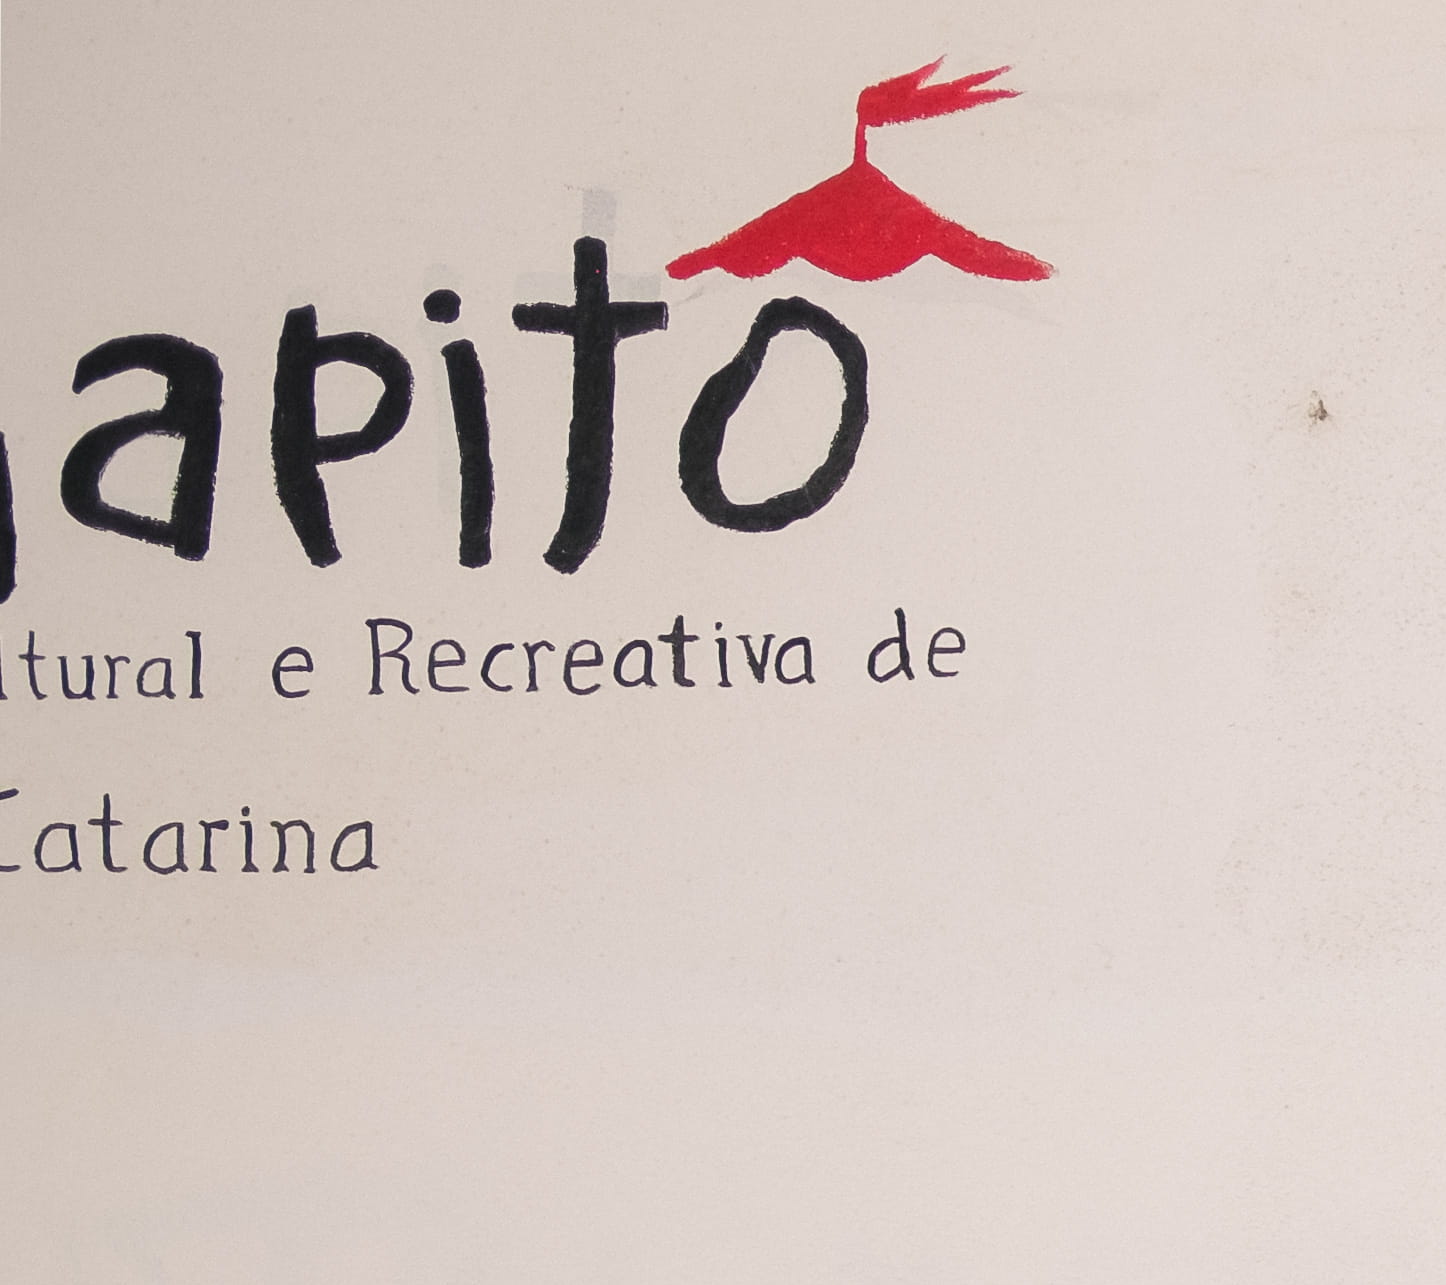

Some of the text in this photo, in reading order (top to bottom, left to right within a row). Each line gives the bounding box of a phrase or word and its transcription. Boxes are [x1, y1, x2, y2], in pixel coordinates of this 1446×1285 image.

[271, 644, 316, 697] e
[366, 615, 816, 698] Recreativa
[866, 608, 968, 682] de
